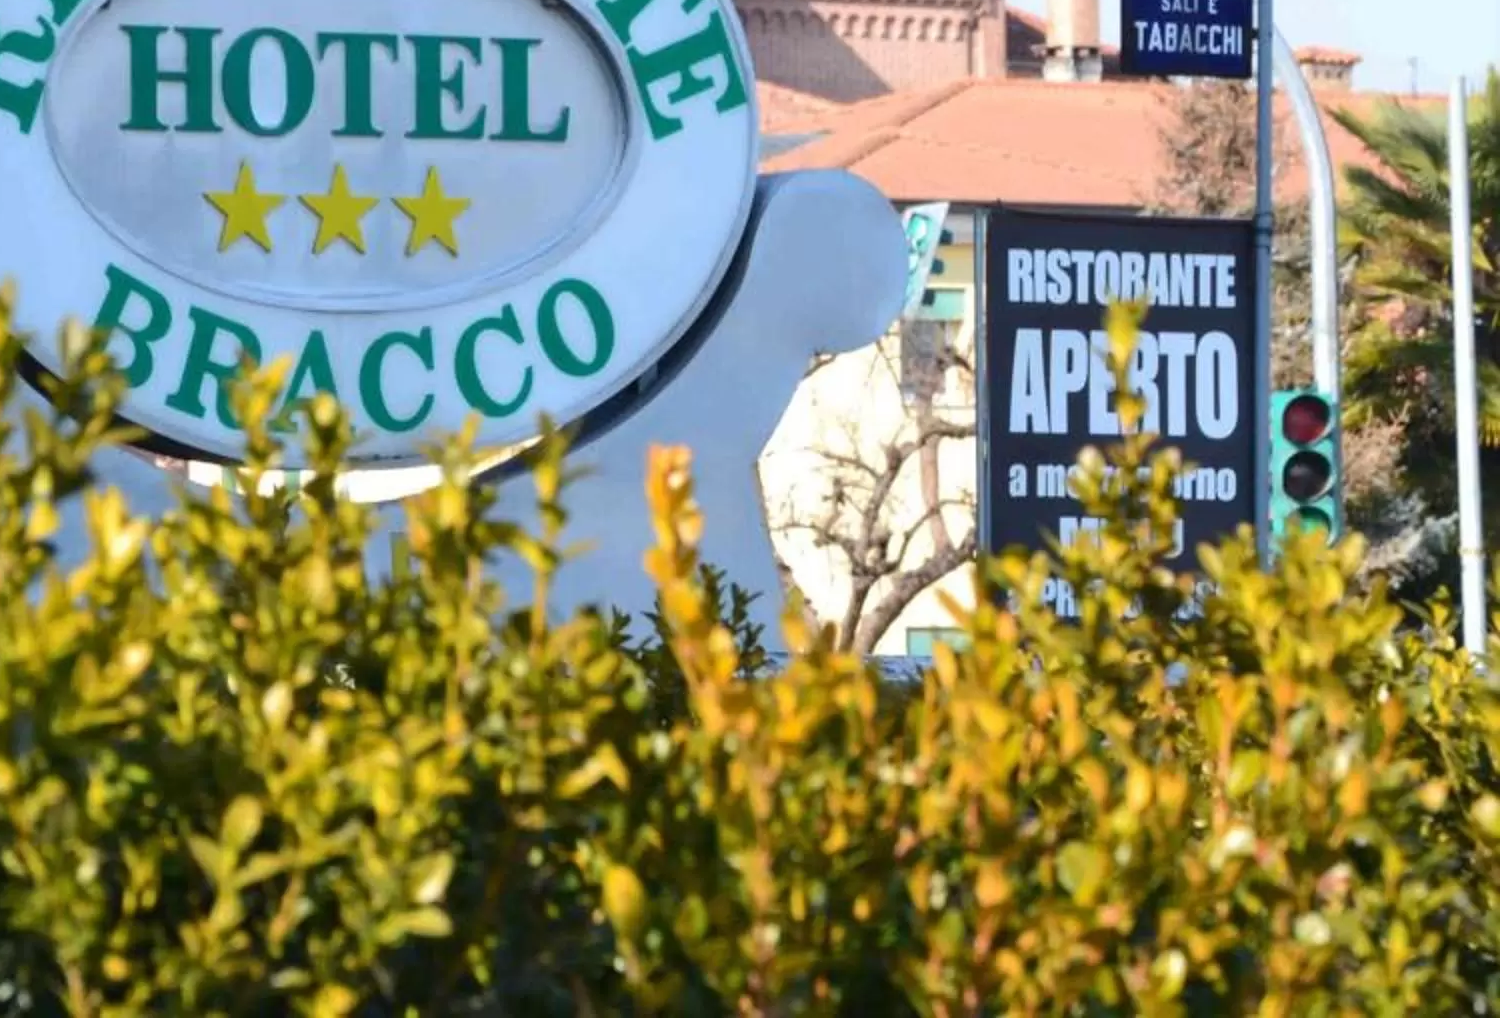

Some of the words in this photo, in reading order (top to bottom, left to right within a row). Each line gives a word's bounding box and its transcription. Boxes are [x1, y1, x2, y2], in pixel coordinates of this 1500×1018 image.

[1134, 20, 1243, 56] TABACCHI
[118, 24, 572, 143] HOTEL
[1007, 248, 1236, 308] RISTORANTE
[90, 263, 616, 434] BRACCO
[1009, 327, 1239, 440] APERTO
[1008, 463, 1028, 498] a
